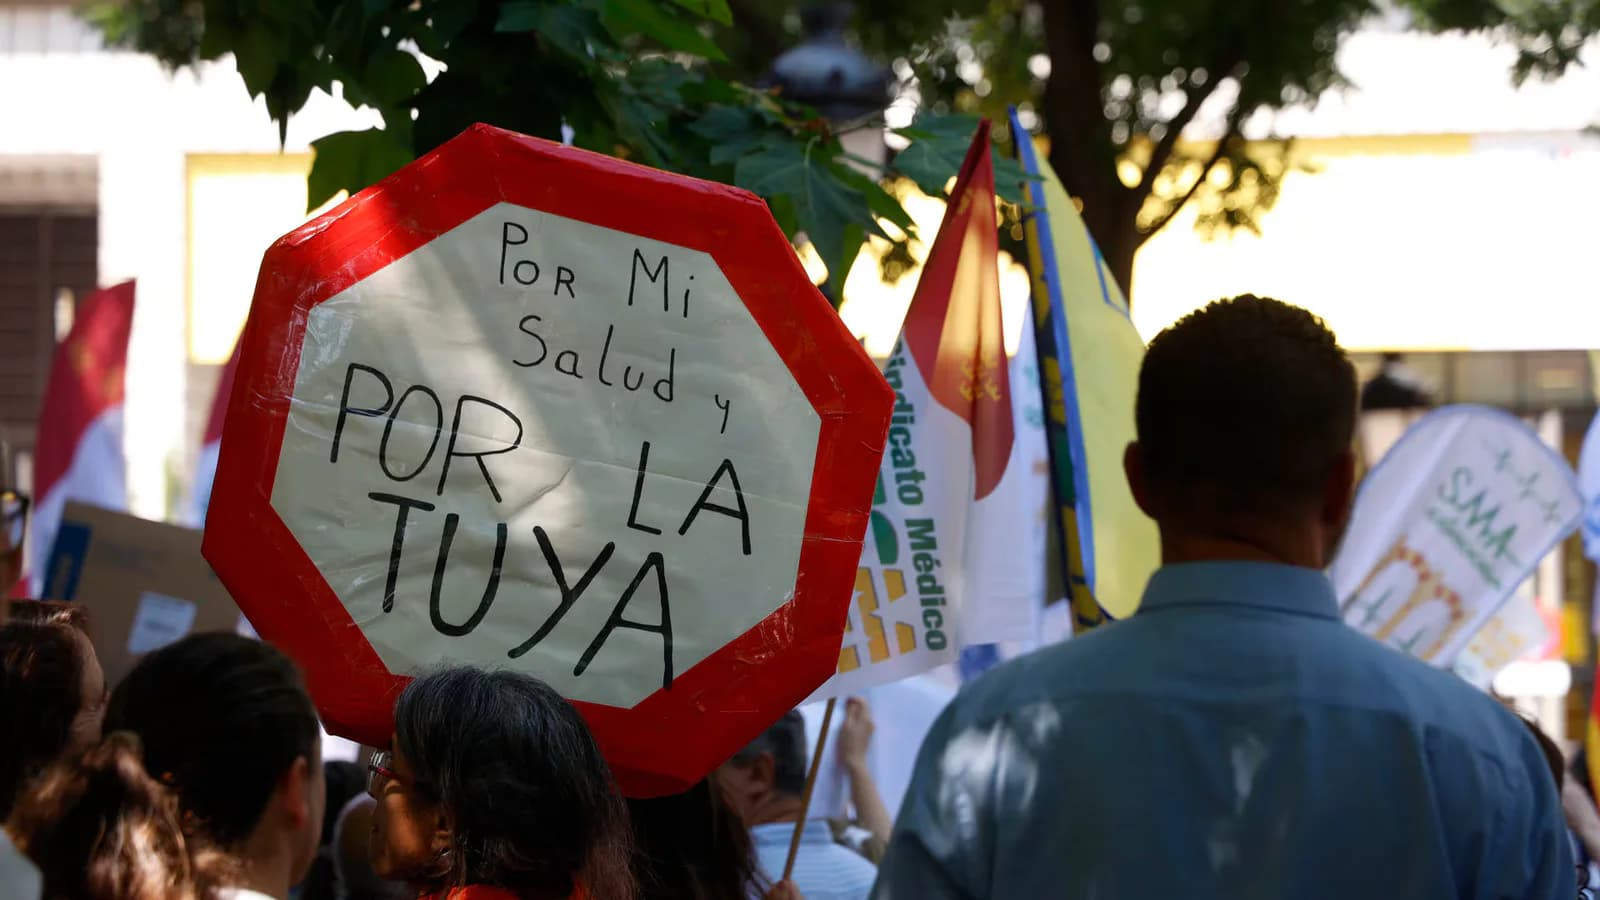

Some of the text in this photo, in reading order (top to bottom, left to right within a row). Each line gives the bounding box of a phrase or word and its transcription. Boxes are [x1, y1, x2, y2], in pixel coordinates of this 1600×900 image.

[628, 248, 696, 318] Mi
[512, 314, 731, 434] Salud y
[330, 362, 752, 556] POR LA
[368, 491, 673, 691] TUYA
[904, 518, 947, 651] Médico
